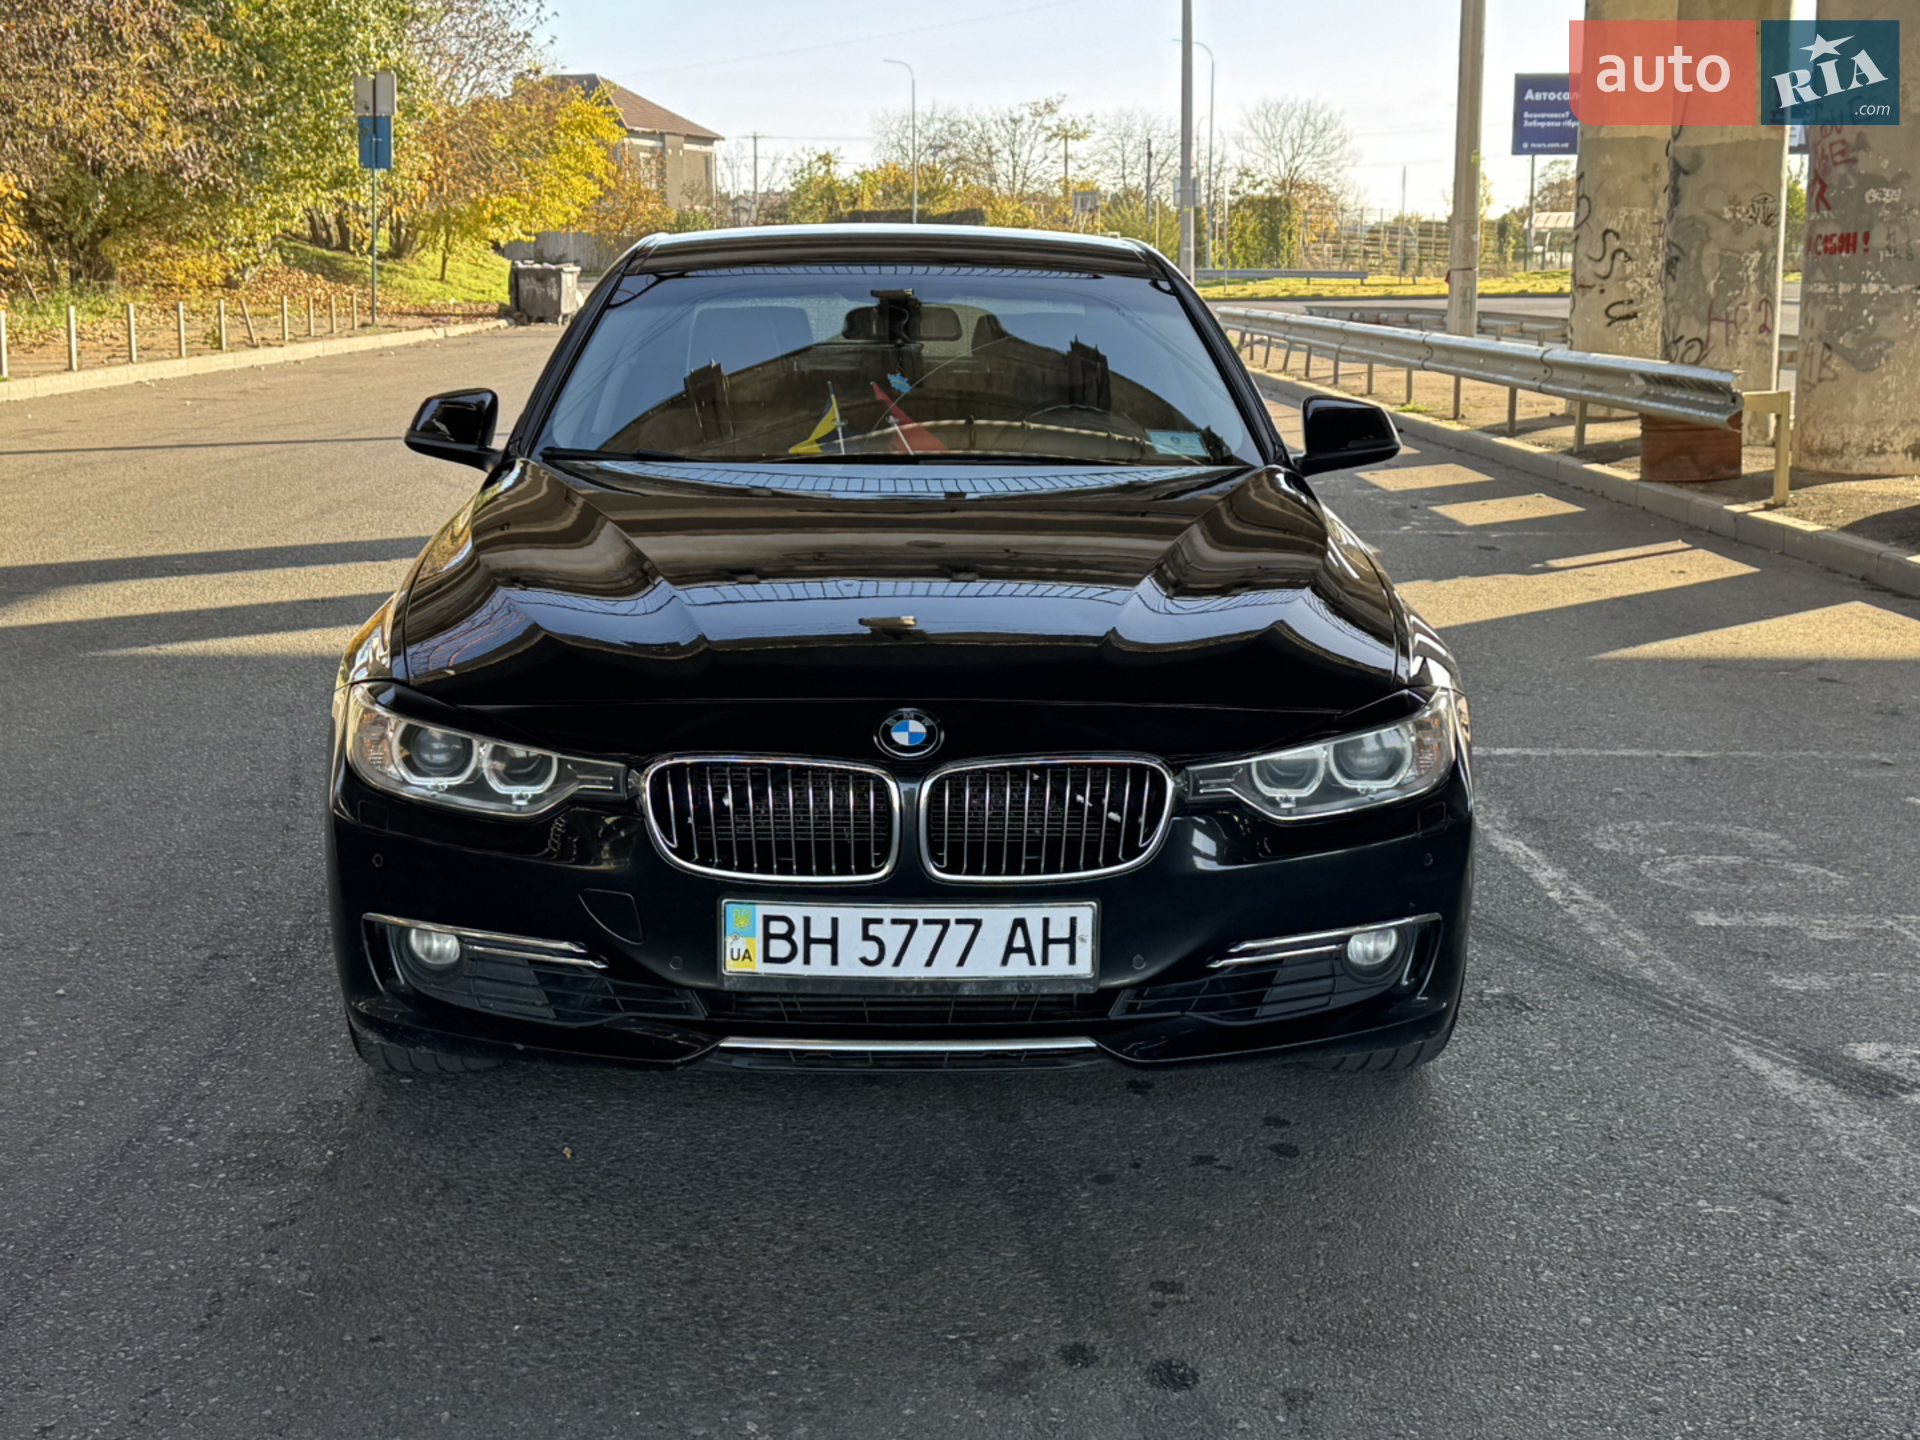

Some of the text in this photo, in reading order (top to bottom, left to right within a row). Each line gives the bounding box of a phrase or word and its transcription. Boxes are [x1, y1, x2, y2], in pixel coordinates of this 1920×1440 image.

[730, 948, 753, 963] UA
[762, 914, 1077, 968] BH 5777 AH
